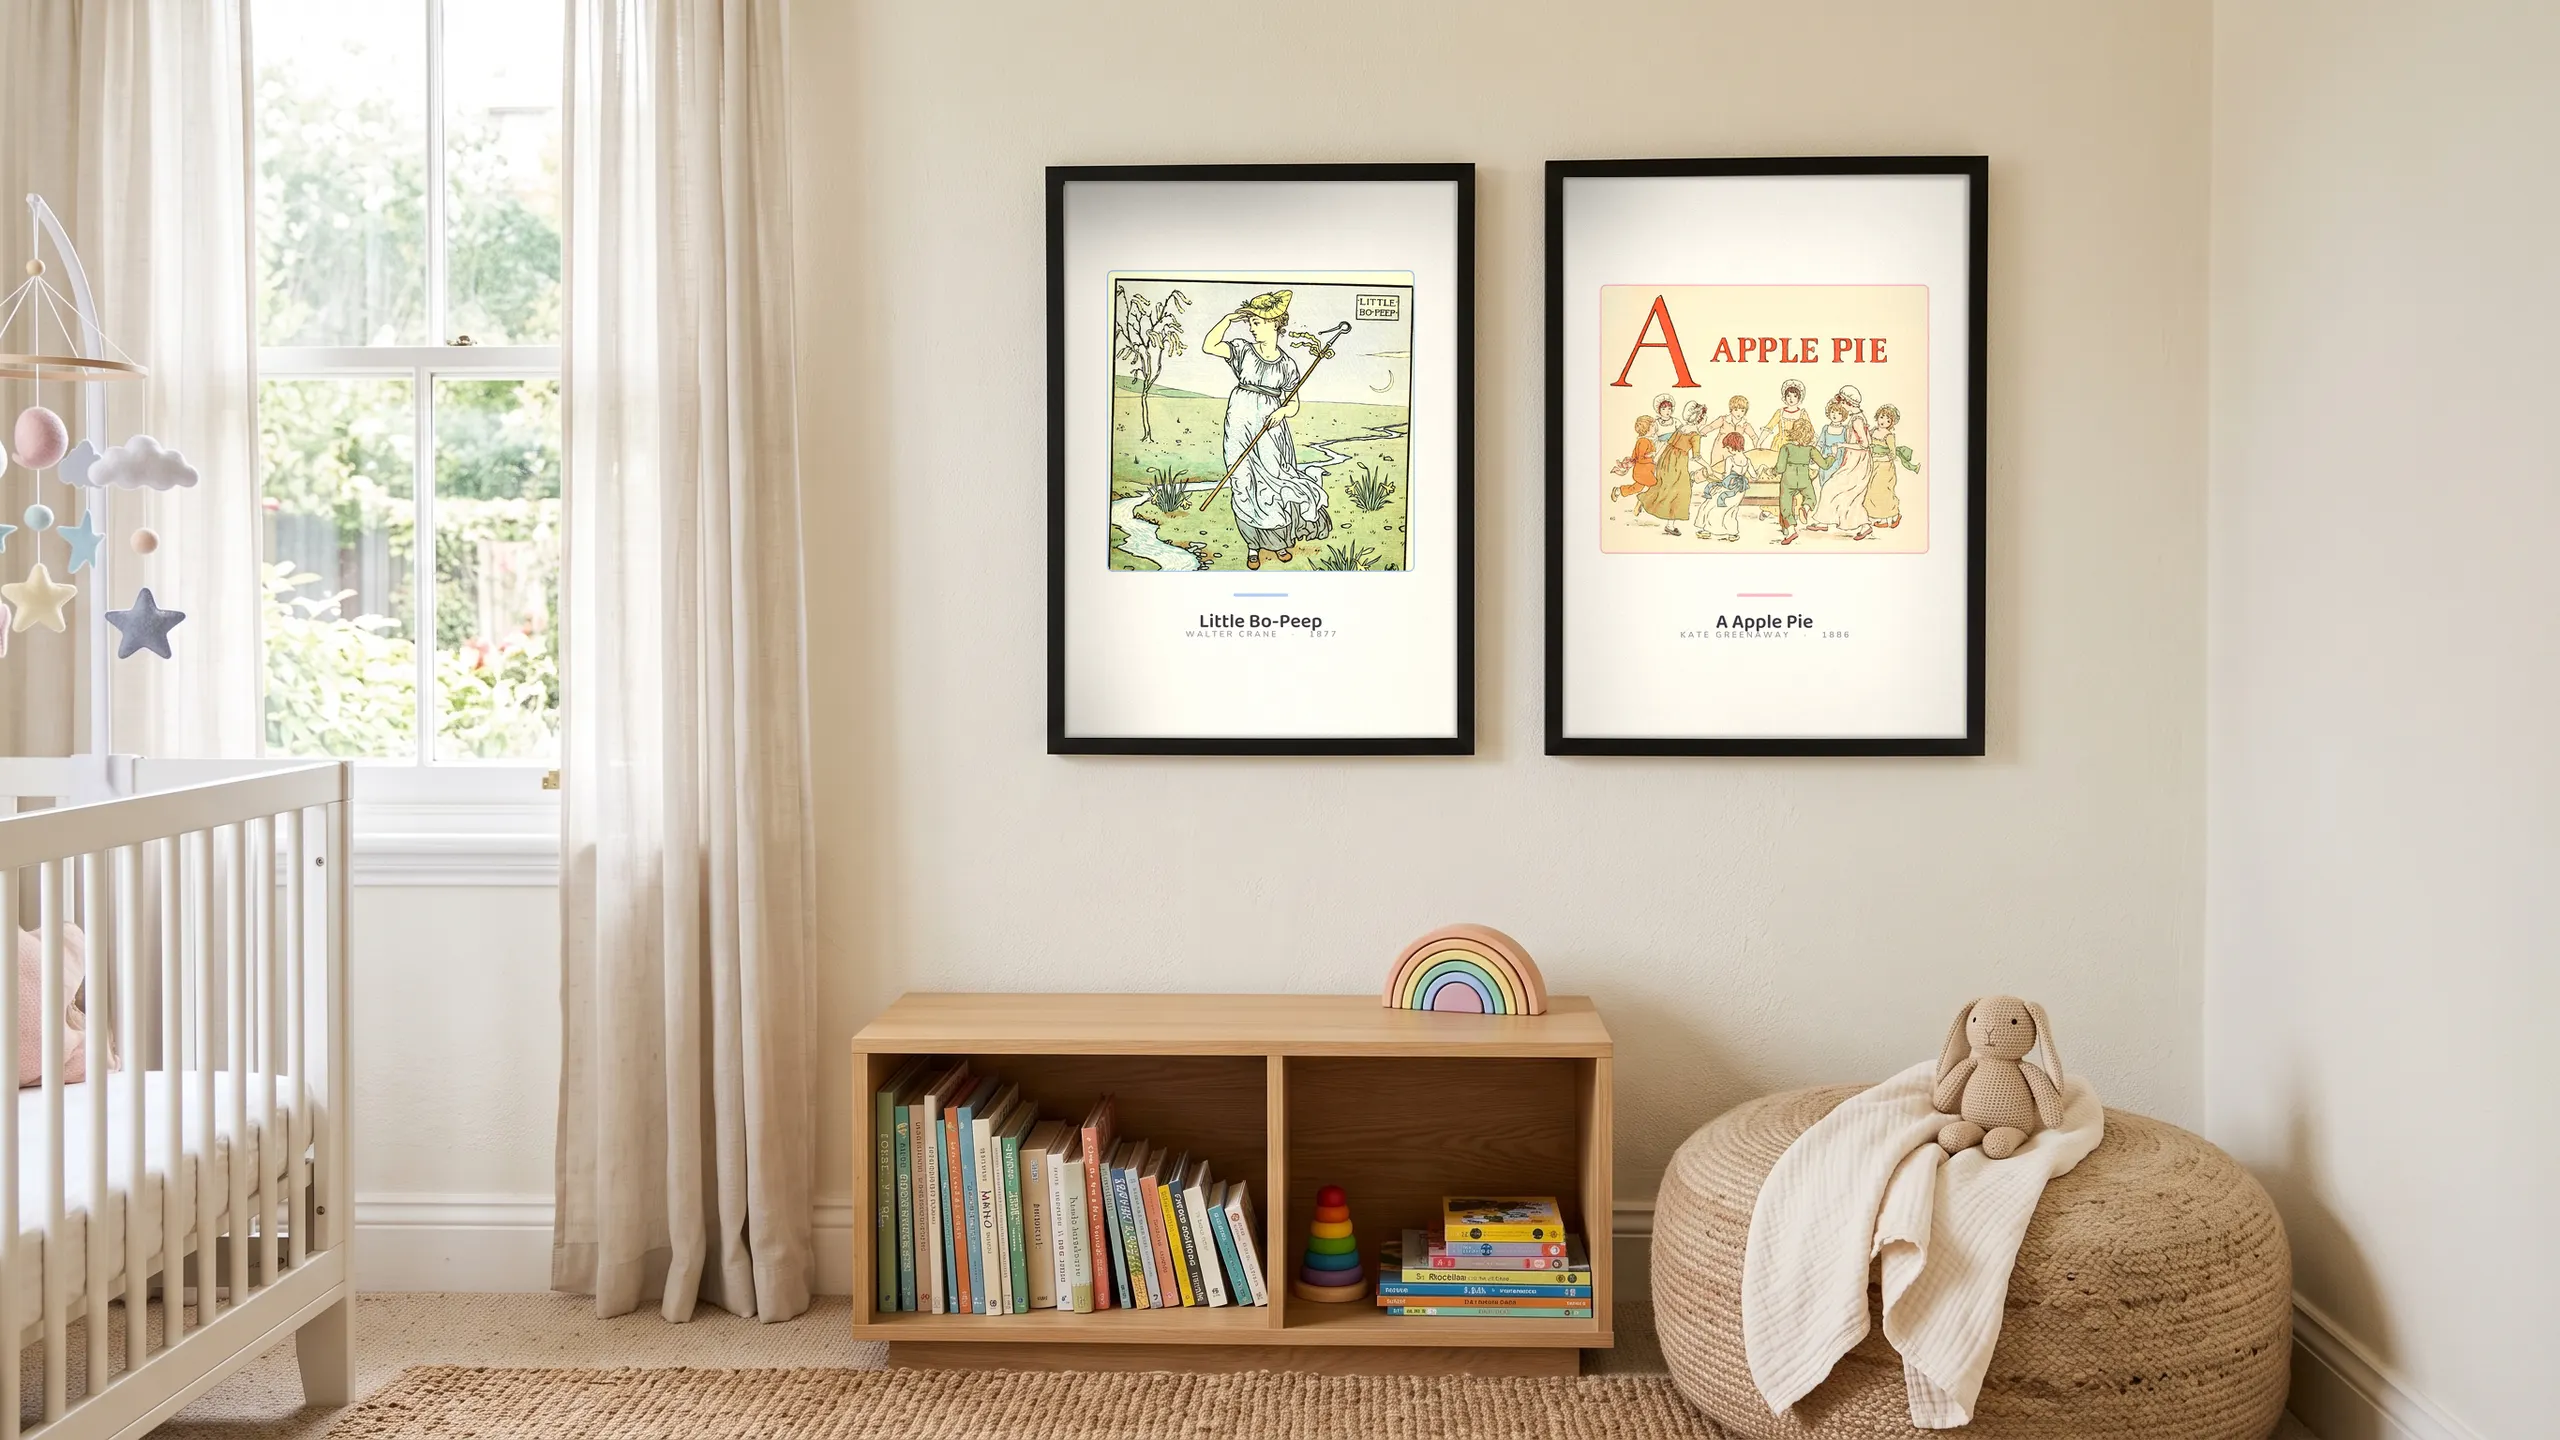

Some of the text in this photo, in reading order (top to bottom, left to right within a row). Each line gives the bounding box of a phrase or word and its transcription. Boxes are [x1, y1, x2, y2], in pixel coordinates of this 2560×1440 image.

[1359, 298, 1397, 307] LITTLE
[1610, 294, 1888, 388] A APPLE PIE
[1200, 613, 1322, 631] Little Bo-Peep
[1716, 613, 1814, 632] A Apple Pie
[1185, 630, 1337, 638] WALTER CRANE 1877
[1680, 631, 1850, 639] KATE GREENAWAY 1886
